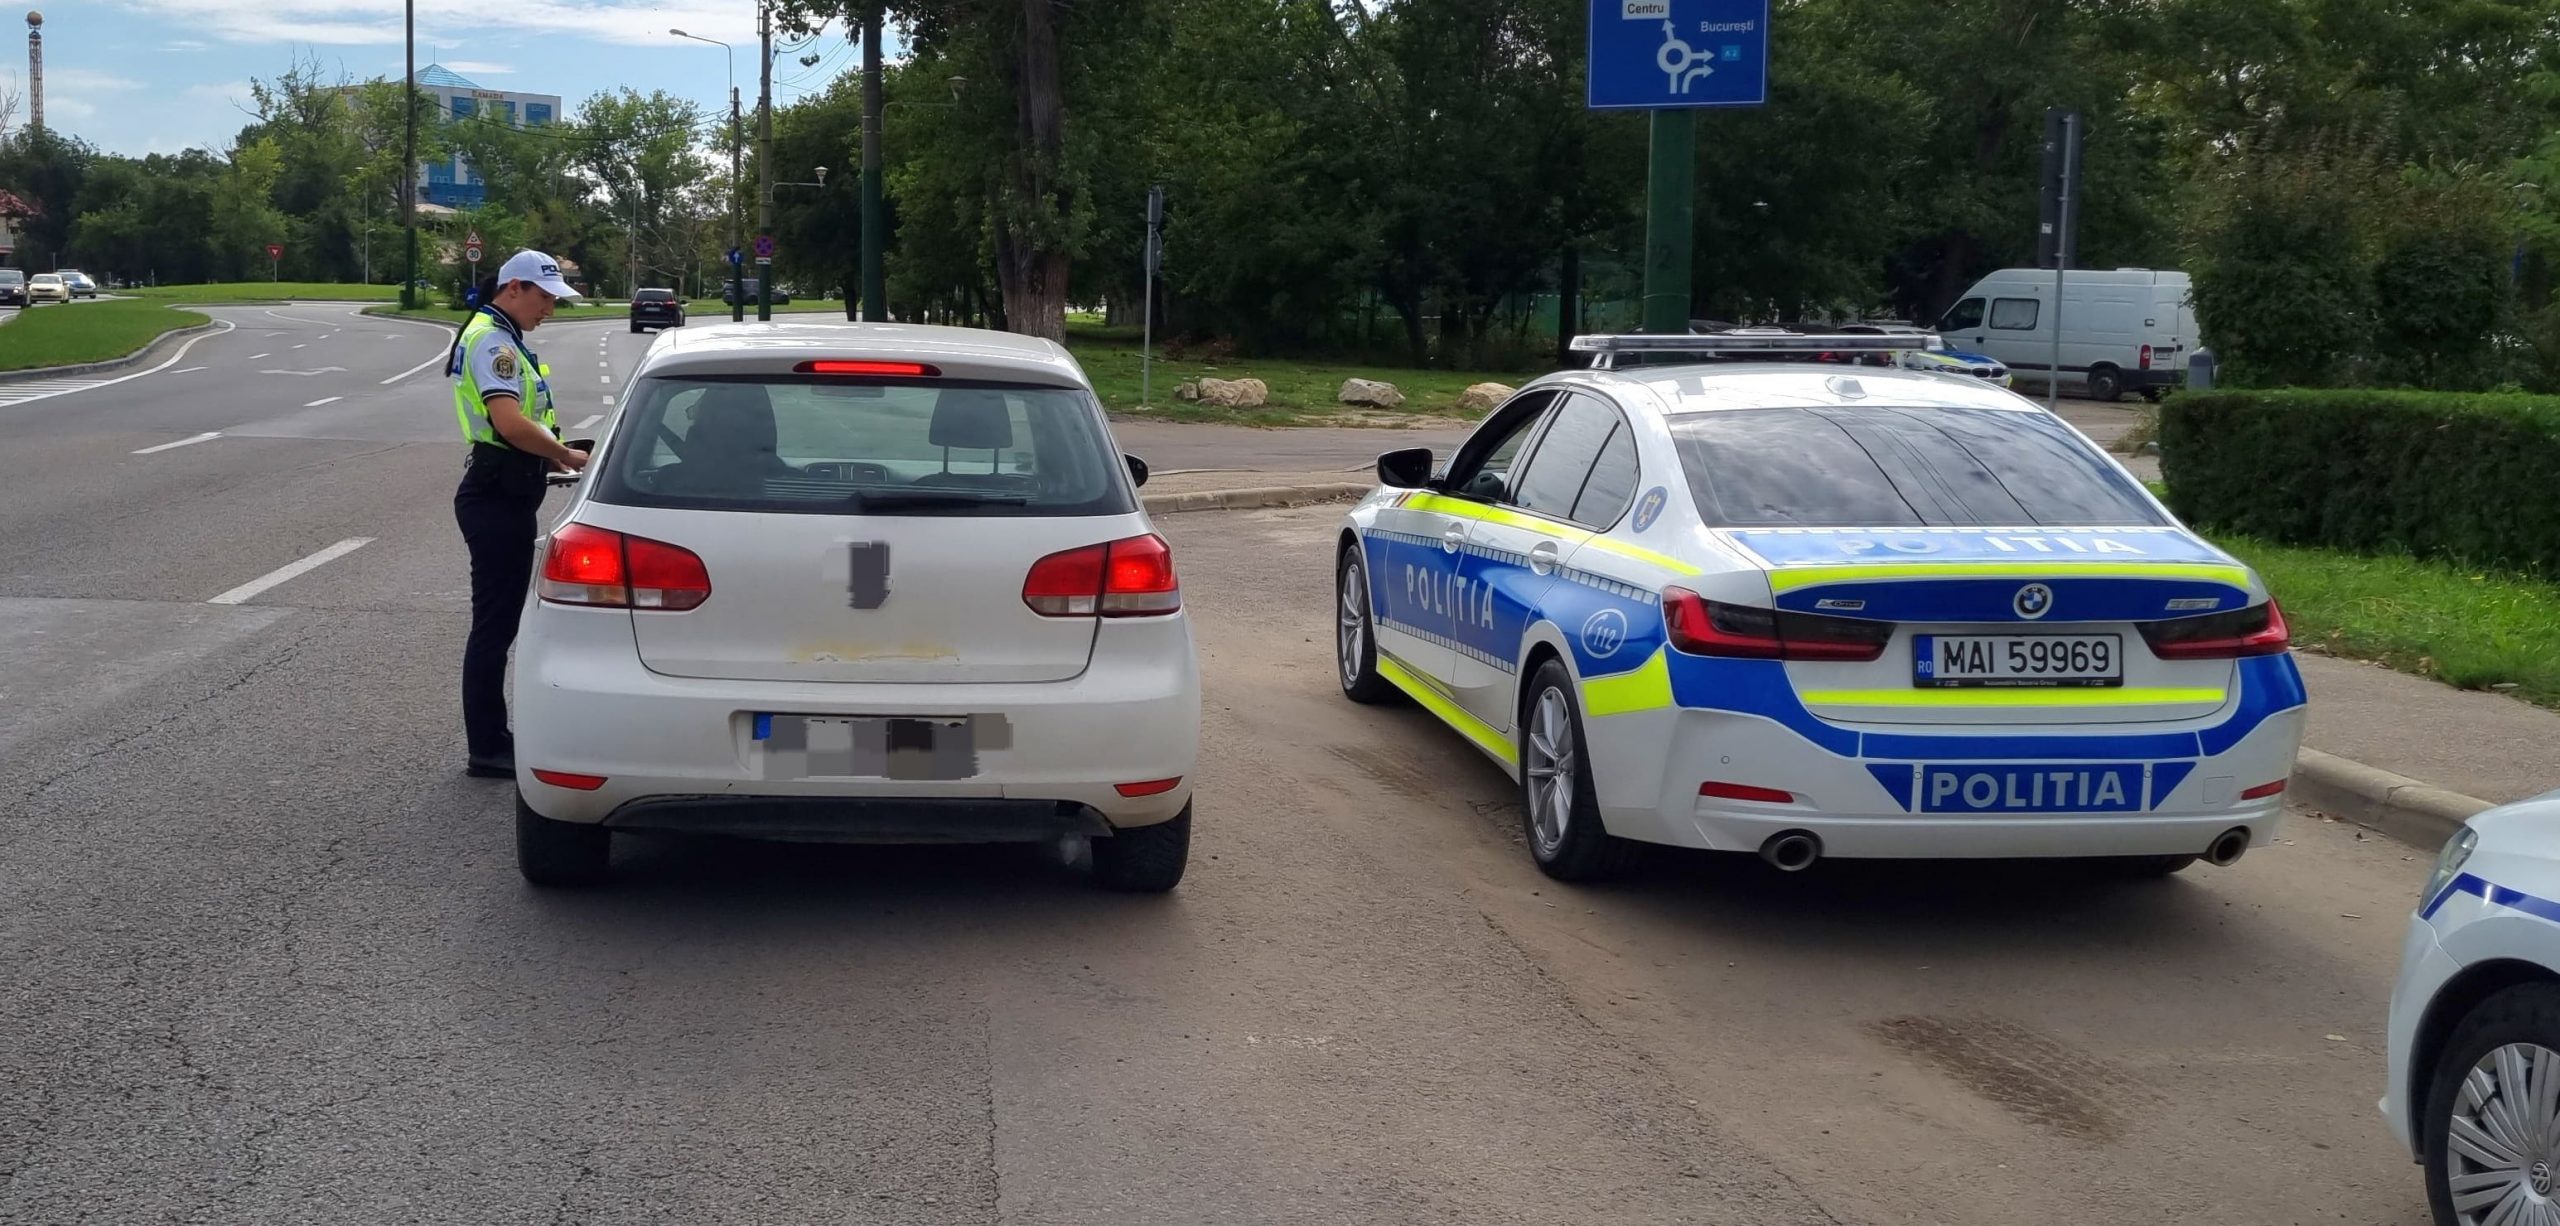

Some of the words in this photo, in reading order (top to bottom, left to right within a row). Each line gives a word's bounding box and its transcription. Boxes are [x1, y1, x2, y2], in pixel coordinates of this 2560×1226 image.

[1627, 3, 1664, 14] Centru
[469, 250, 478, 259] 30
[1406, 563, 1494, 631] POLITIA
[1594, 625, 1617, 651] 112
[1917, 660, 1933, 674] RO
[1943, 641, 1995, 674] MAI
[2008, 640, 2111, 674] 59969
[1931, 771, 2126, 808] POLITIA
